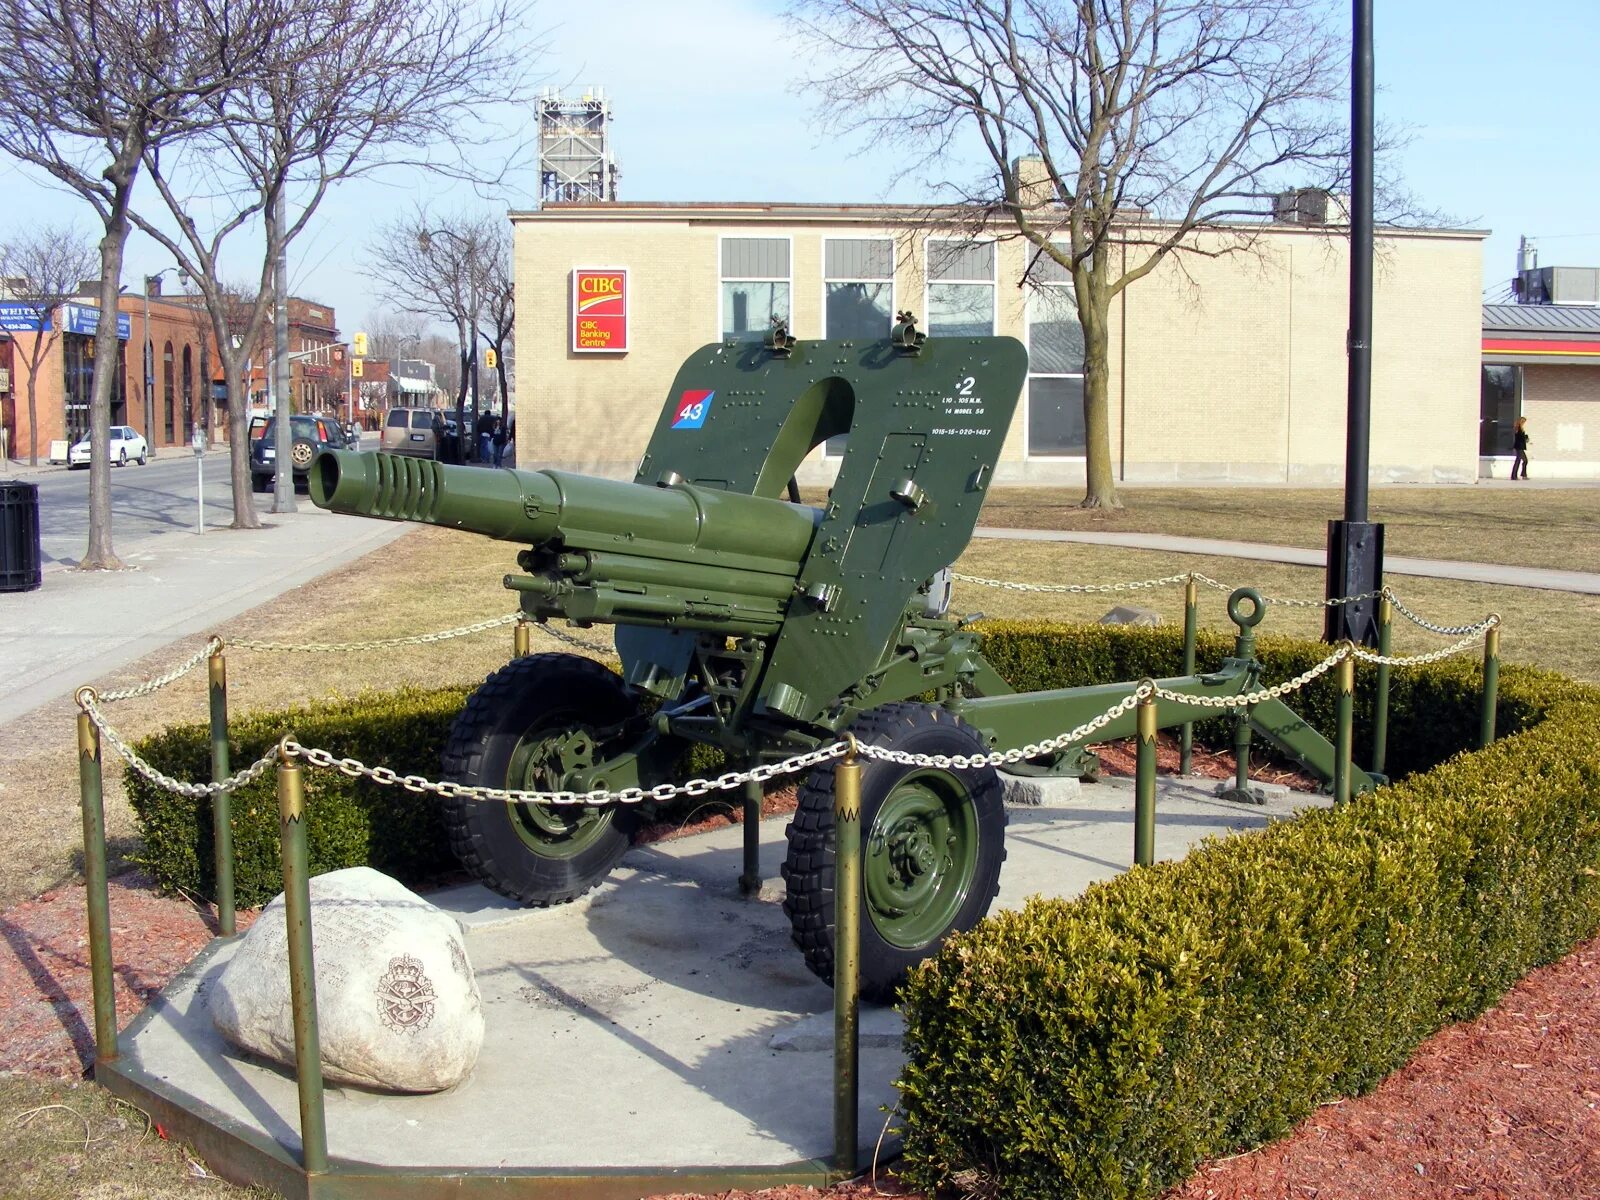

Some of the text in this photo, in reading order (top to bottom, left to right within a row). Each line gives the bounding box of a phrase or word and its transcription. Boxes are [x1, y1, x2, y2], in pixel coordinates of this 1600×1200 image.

[581, 277, 621, 293] CIBC
[580, 321, 598, 329] CIBC
[580, 330, 610, 339] Banking
[580, 339, 606, 347] Centre
[680, 403, 704, 420] 43
